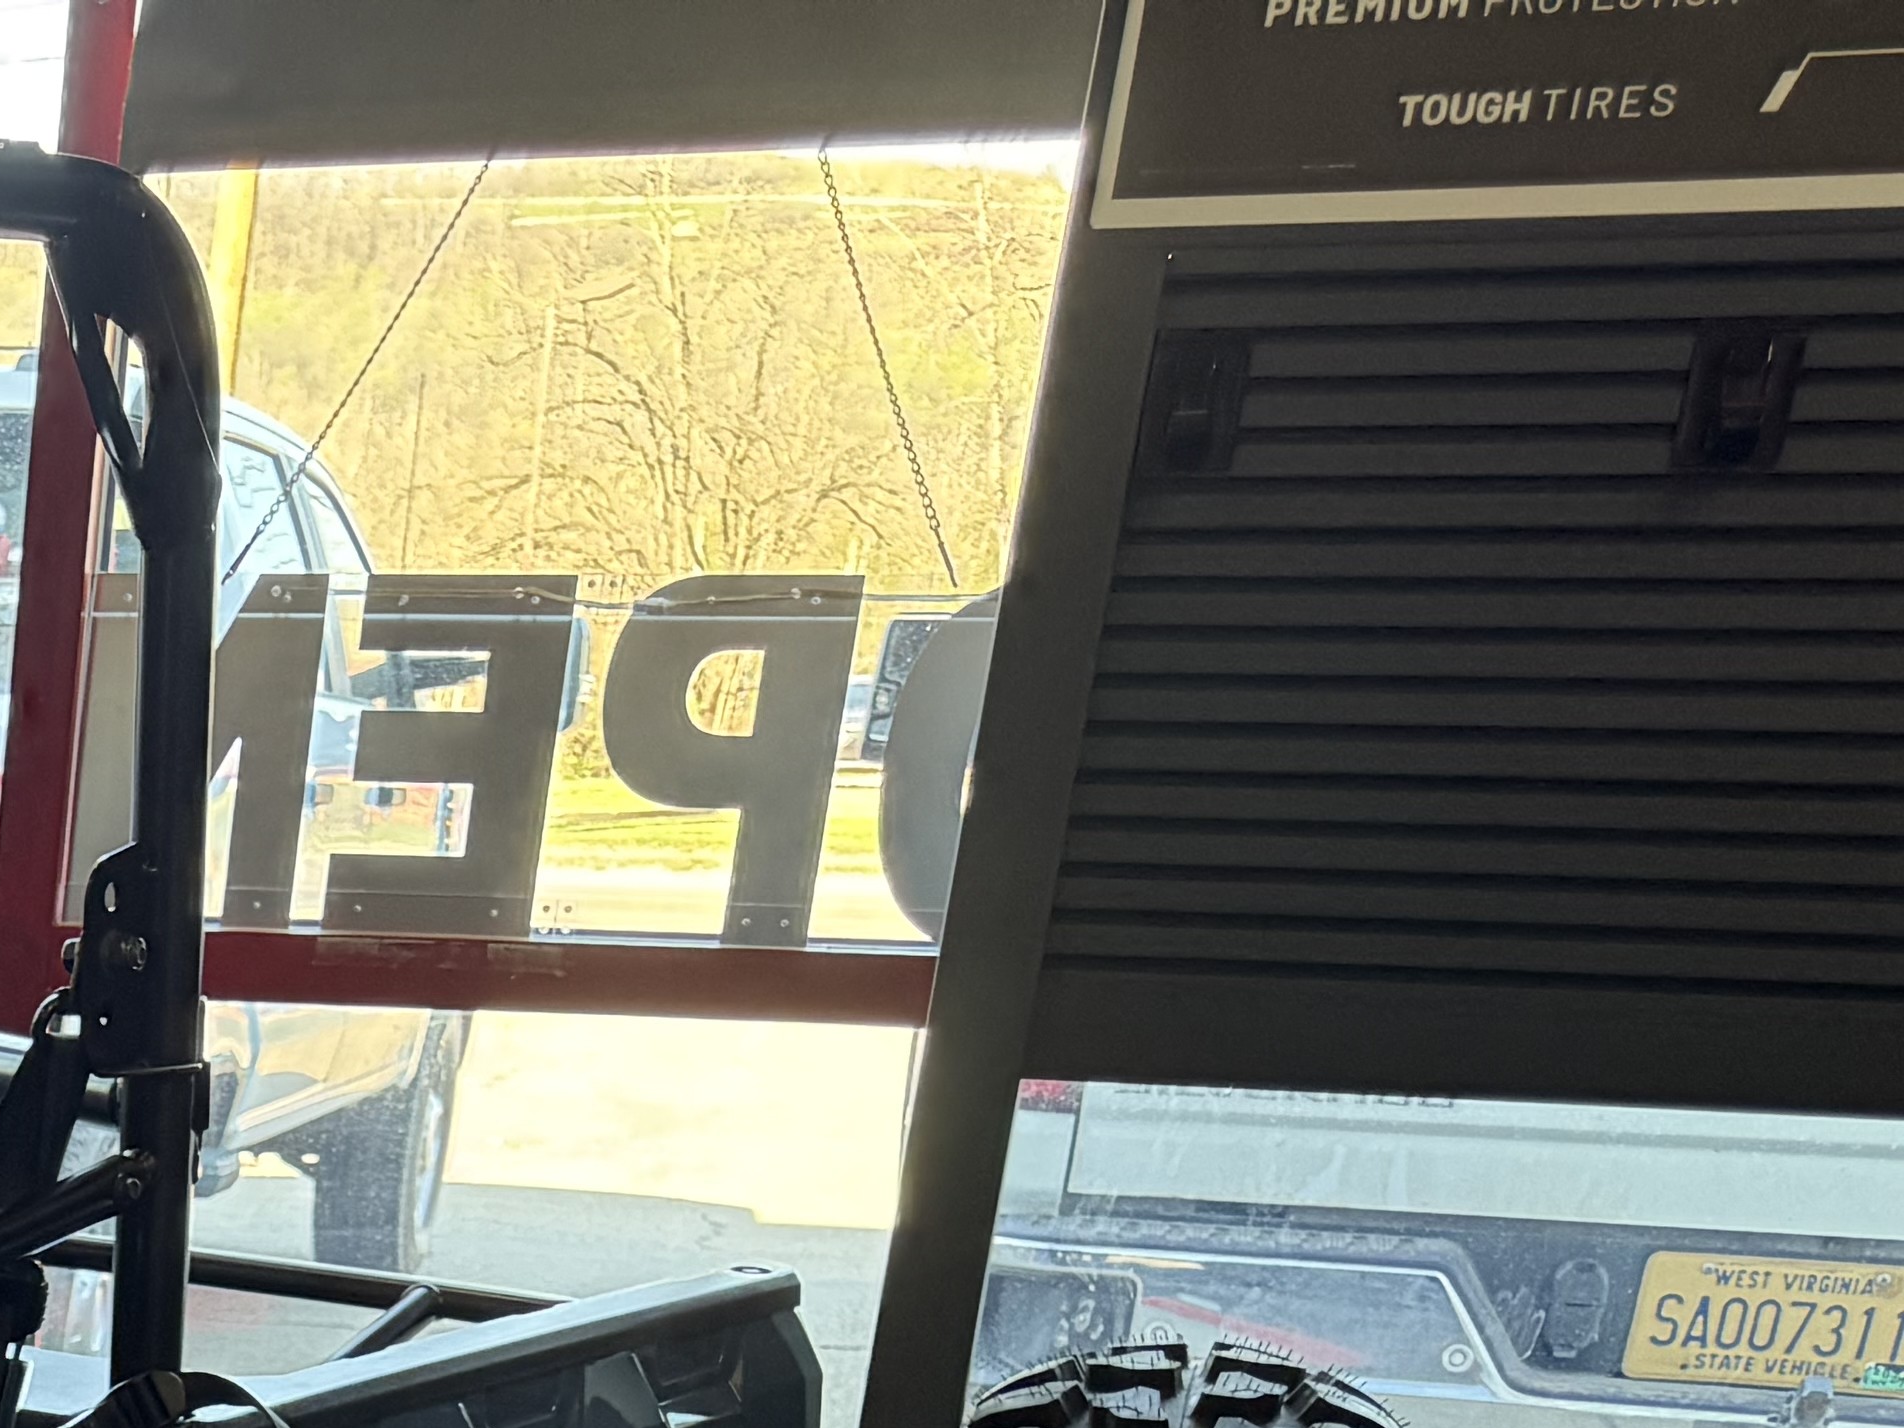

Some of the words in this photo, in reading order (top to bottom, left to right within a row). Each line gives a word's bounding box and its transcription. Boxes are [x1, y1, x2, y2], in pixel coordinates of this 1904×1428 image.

[1399, 90, 1533, 128] TOUGH
[1541, 84, 1679, 122] TIRES
[1715, 1268, 1773, 1290] WEST
[1784, 1272, 1876, 1296] VIRGINIA
[1694, 1353, 1755, 1373] STATE
[1764, 1358, 1852, 1380] VEHICLE
